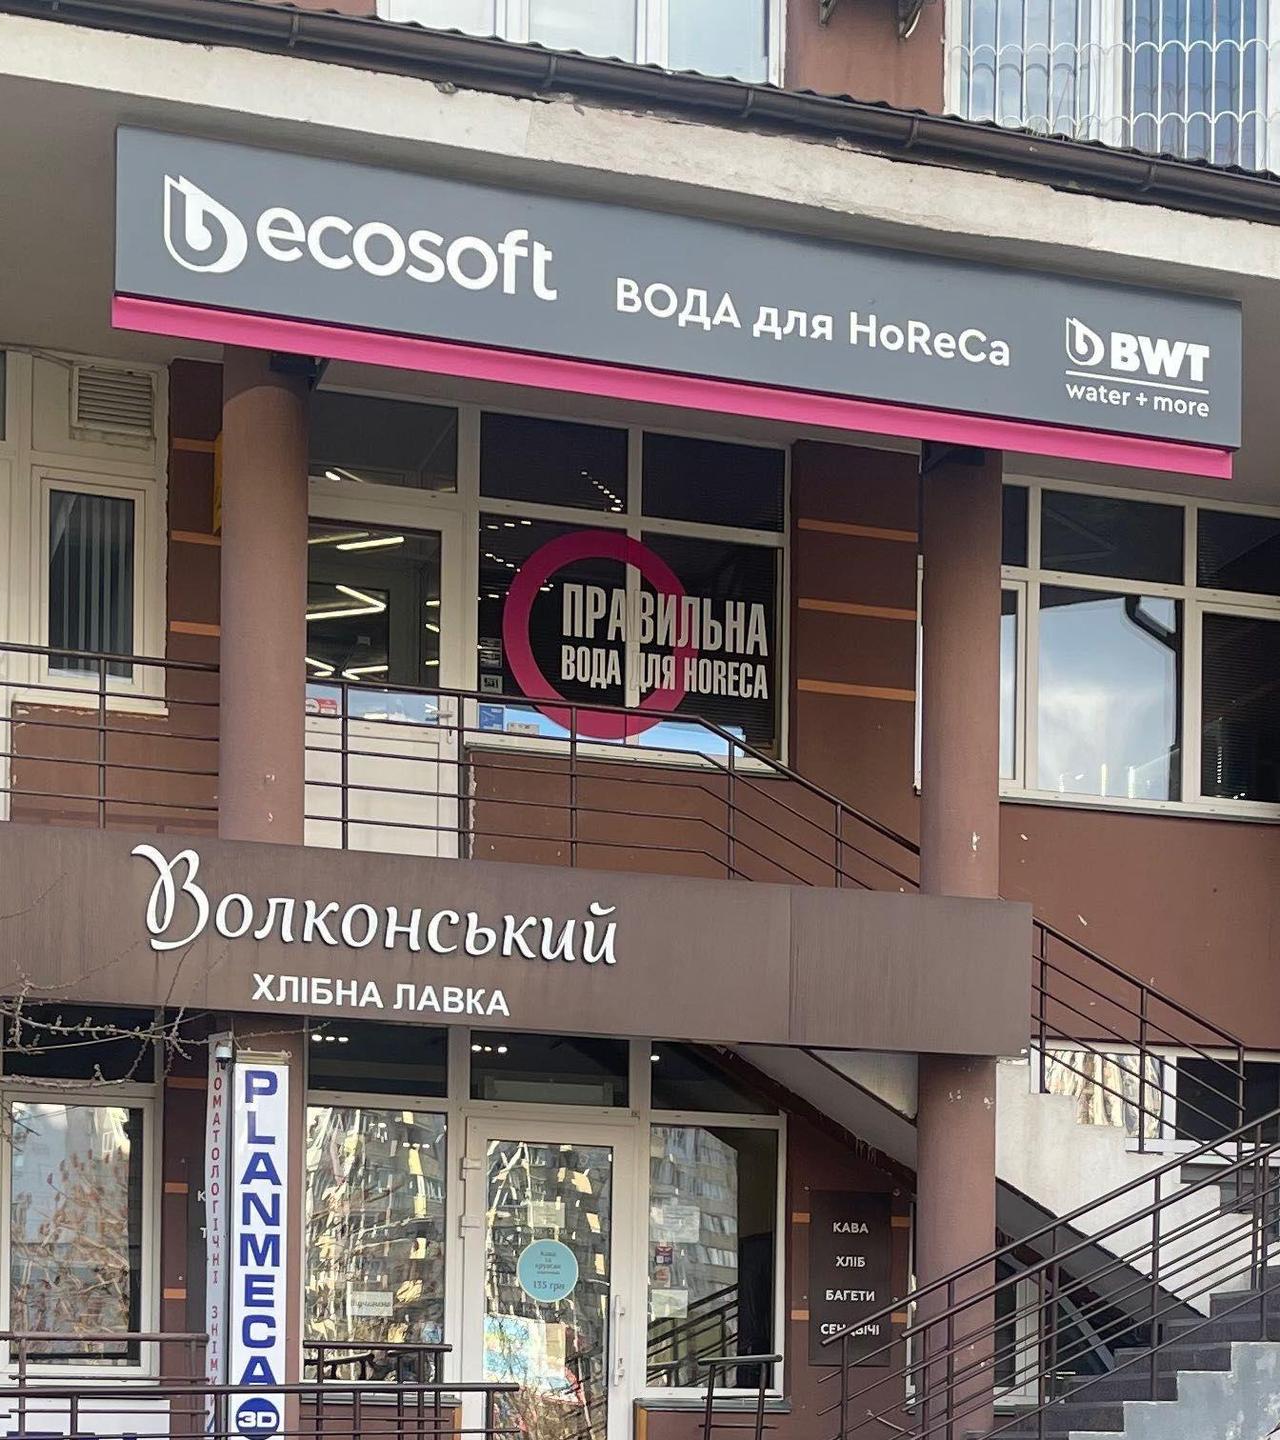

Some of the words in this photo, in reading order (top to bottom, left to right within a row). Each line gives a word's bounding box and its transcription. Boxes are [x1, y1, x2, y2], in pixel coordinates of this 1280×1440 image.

[256, 206, 558, 301] ecosoft
[616, 277, 741, 332] ВОДА
[752, 304, 833, 341] для
[849, 311, 1010, 367] HoReCa
[1110, 331, 1211, 382] BWT
[1065, 383, 1131, 407] water
[1153, 395, 1210, 418] more
[561, 582, 769, 658] ПРАВИЛЬНА
[561, 644, 622, 690] ВОДА
[629, 651, 676, 694] ДЛЯ
[683, 656, 769, 700] HORECA
[131, 843, 618, 965] Волконський
[251, 972, 384, 1010] ХЛІБНА
[393, 982, 511, 1018] ЛАВКА
[239, 1069, 283, 1390] PLANMECA
[832, 1222, 869, 1234] КАВА
[835, 1255, 866, 1268] ХЛІБ
[825, 1289, 876, 1302] БАГЕТИ
[820, 1323, 880, 1337] СЕНВІЧІ
[237, 1410, 277, 1429] 3D
